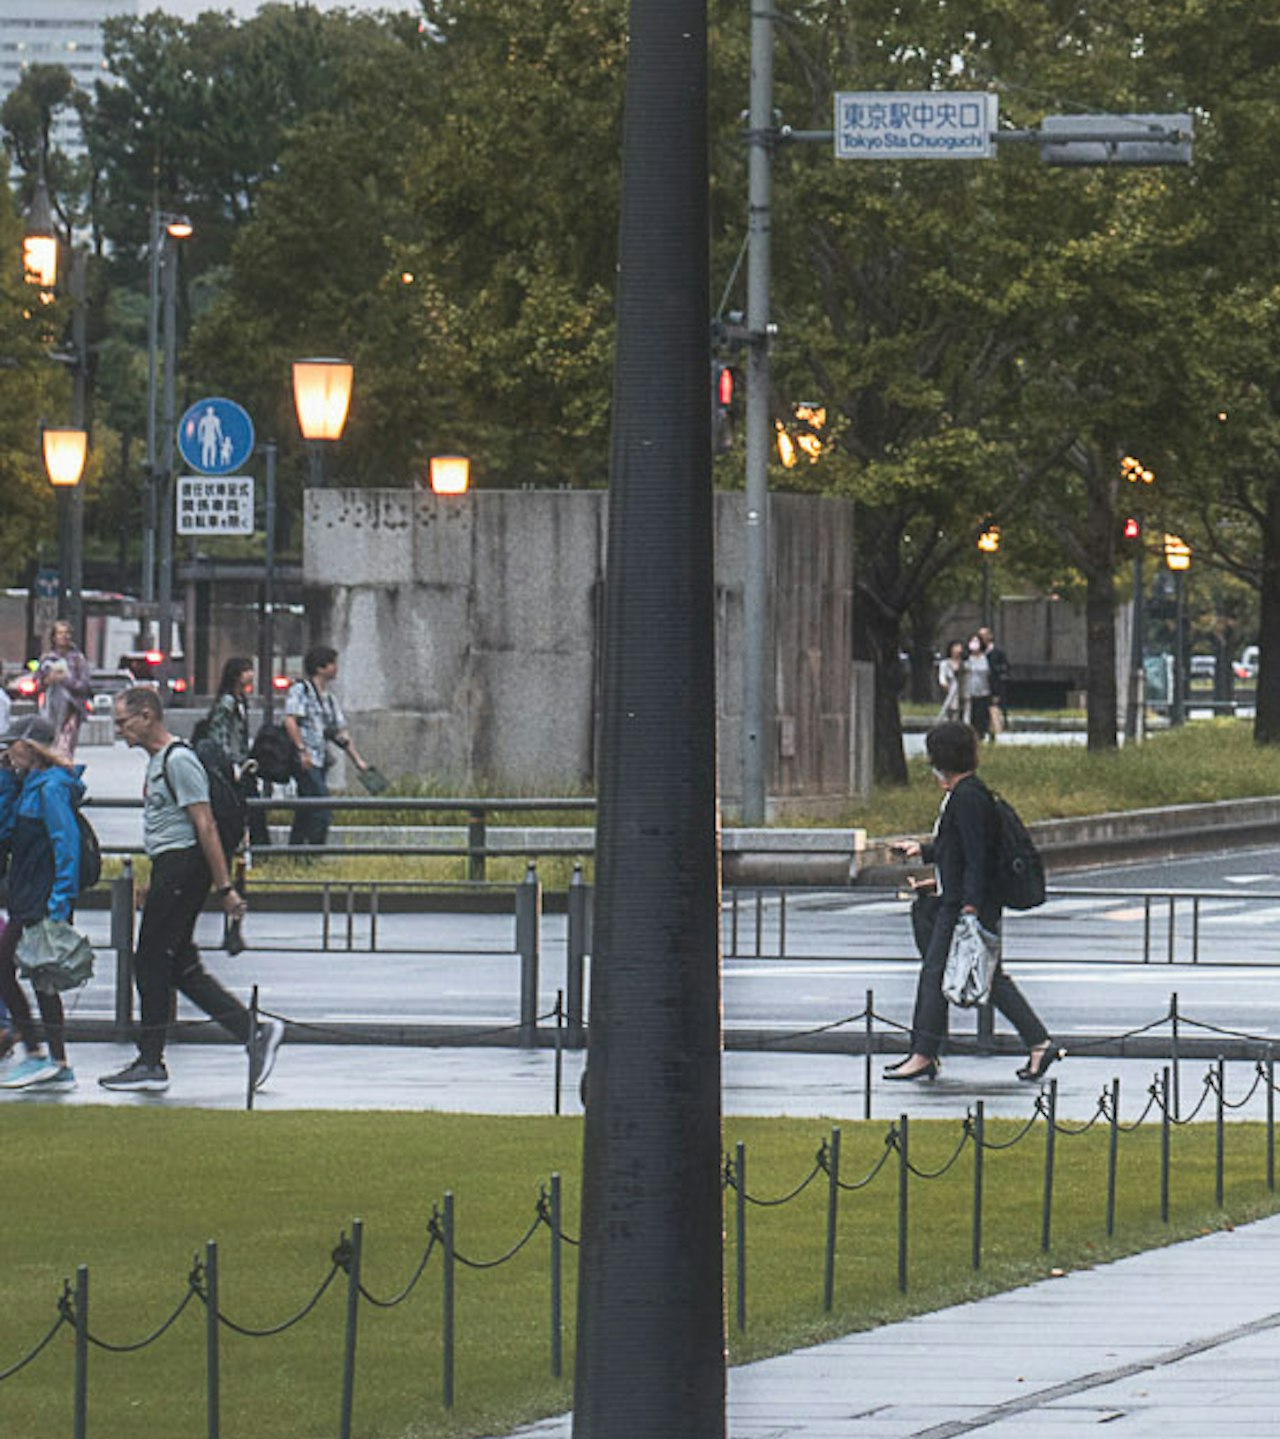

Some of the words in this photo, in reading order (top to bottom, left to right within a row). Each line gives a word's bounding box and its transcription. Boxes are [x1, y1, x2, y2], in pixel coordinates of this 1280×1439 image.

[843, 101, 980, 129] 東京駅中央口
[843, 133, 883, 149] Tokyo
[884, 132, 907, 148] Sta
[910, 133, 982, 149] Chuoguchi
